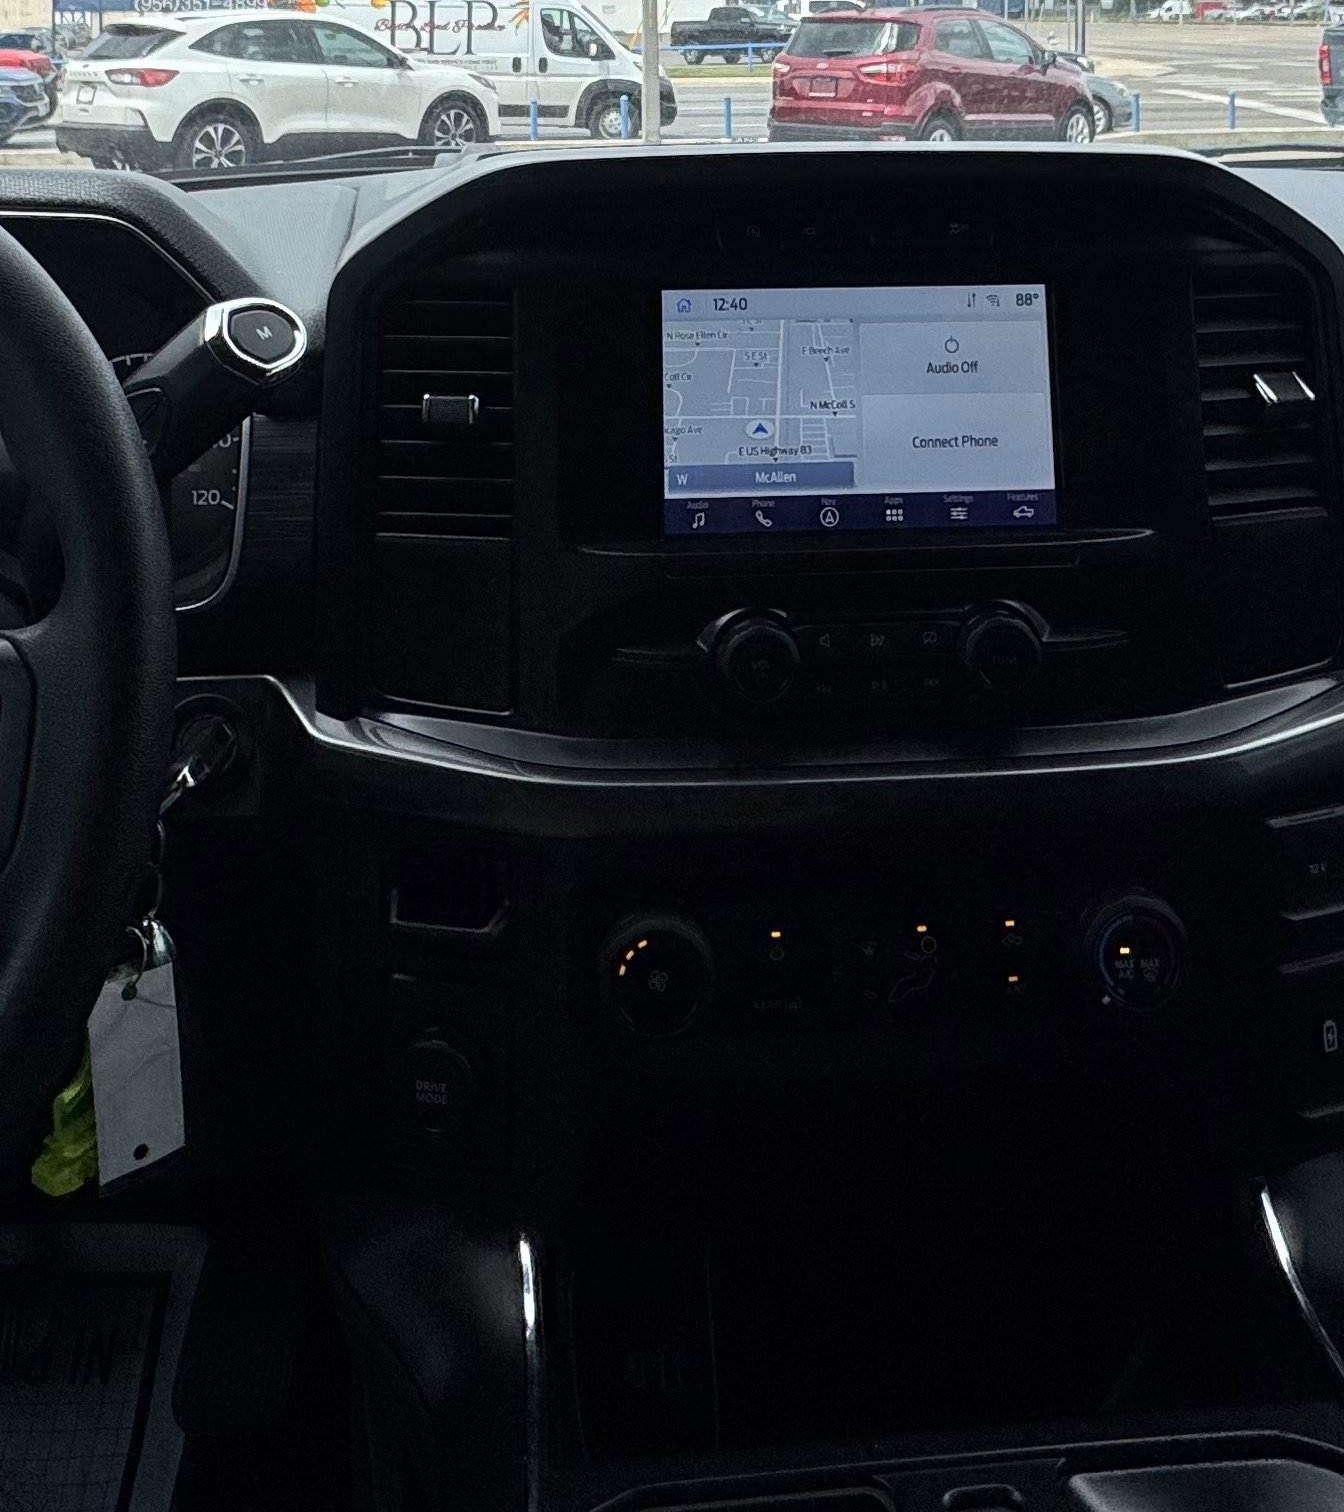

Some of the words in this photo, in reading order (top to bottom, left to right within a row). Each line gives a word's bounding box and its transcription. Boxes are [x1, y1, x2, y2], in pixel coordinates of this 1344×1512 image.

[388, 0, 498, 55] BLP
[712, 297, 749, 312] 12:40
[1015, 293, 1040, 307] 88°
[255, 325, 274, 341] M
[667, 331, 674, 340] N
[926, 361, 959, 375] Audio
[961, 360, 978, 374] Off
[810, 401, 817, 410] N
[818, 399, 846, 409] McColl
[849, 399, 856, 409] S
[687, 425, 703, 434] Ave
[912, 434, 959, 450] Connect
[960, 433, 999, 449] Phone
[746, 446, 758, 456] US
[760, 445, 798, 458] Highway
[676, 474, 688, 486] W
[755, 470, 798, 485] McAllen
[191, 489, 222, 506] 120
[415, 1079, 449, 1092] DRIVE
[415, 1092, 449, 1105] MODE
